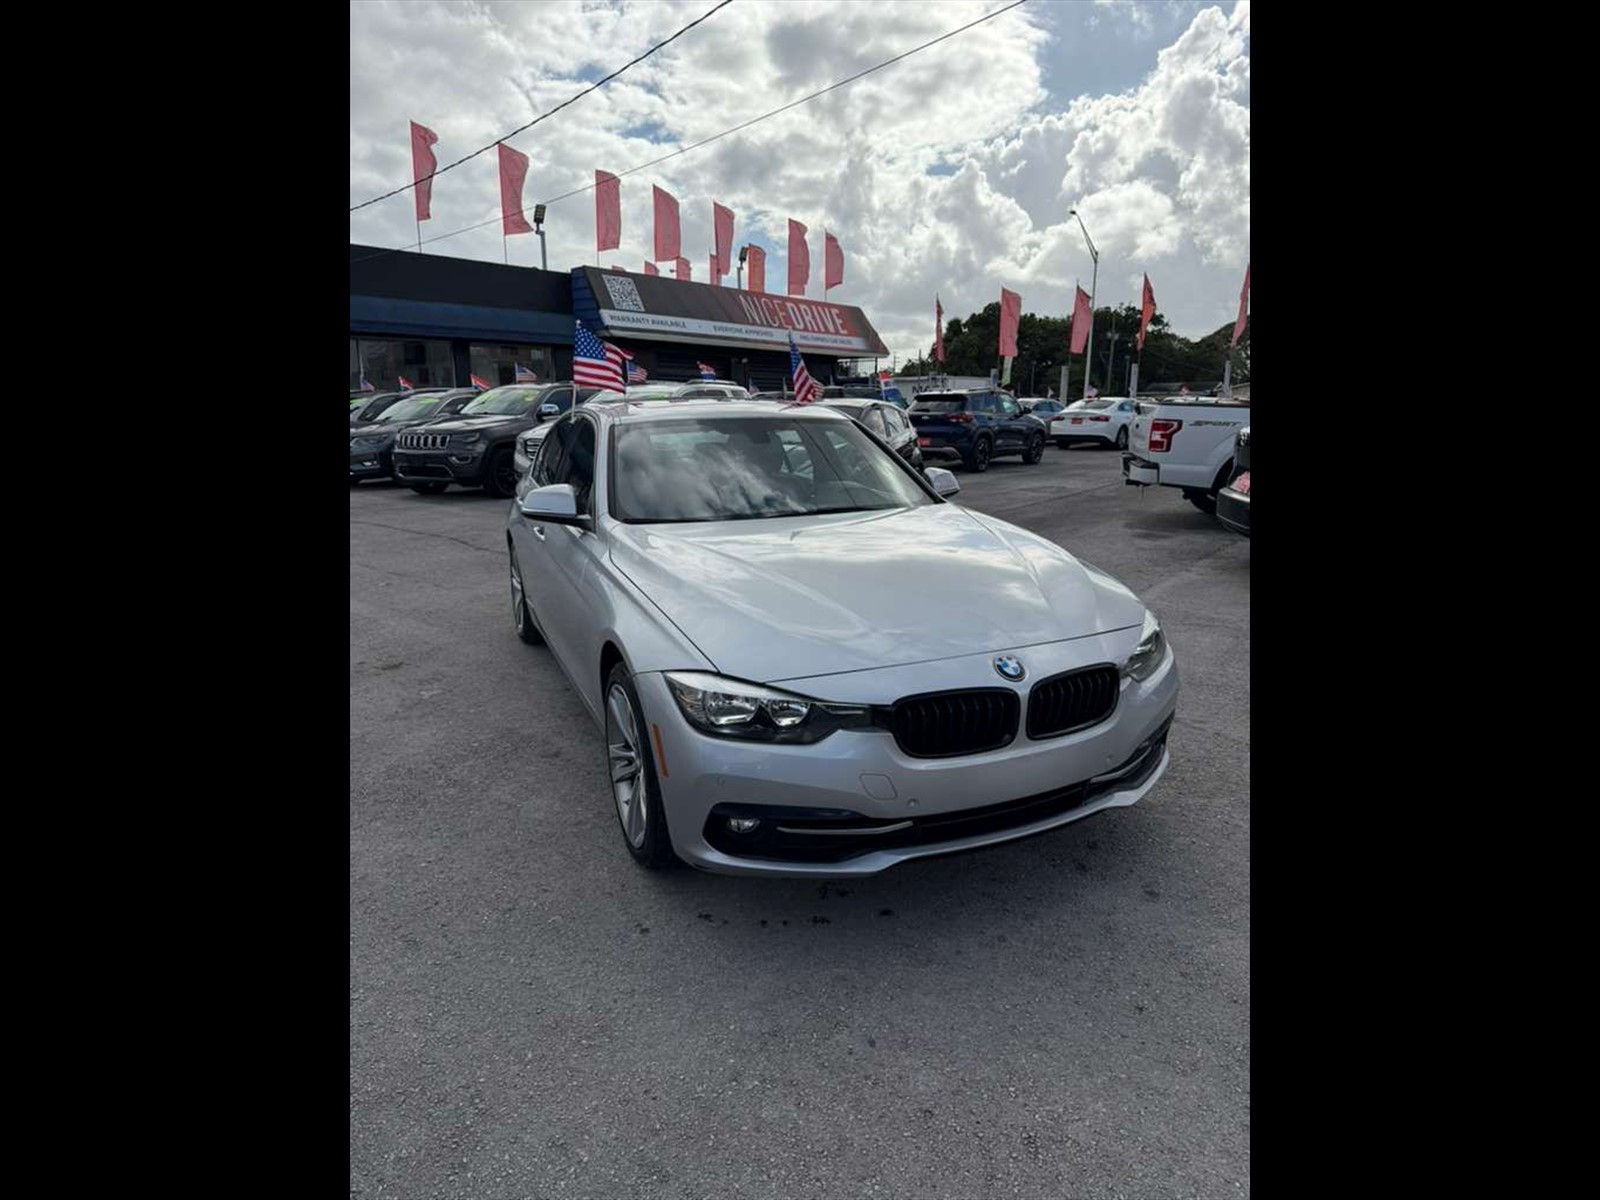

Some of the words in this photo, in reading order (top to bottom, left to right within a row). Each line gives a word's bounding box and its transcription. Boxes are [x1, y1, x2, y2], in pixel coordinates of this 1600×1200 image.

[609, 315, 650, 325] WARRANTY
[651, 319, 688, 329] AVAILABLE
[1189, 420, 1242, 428] SPORT
